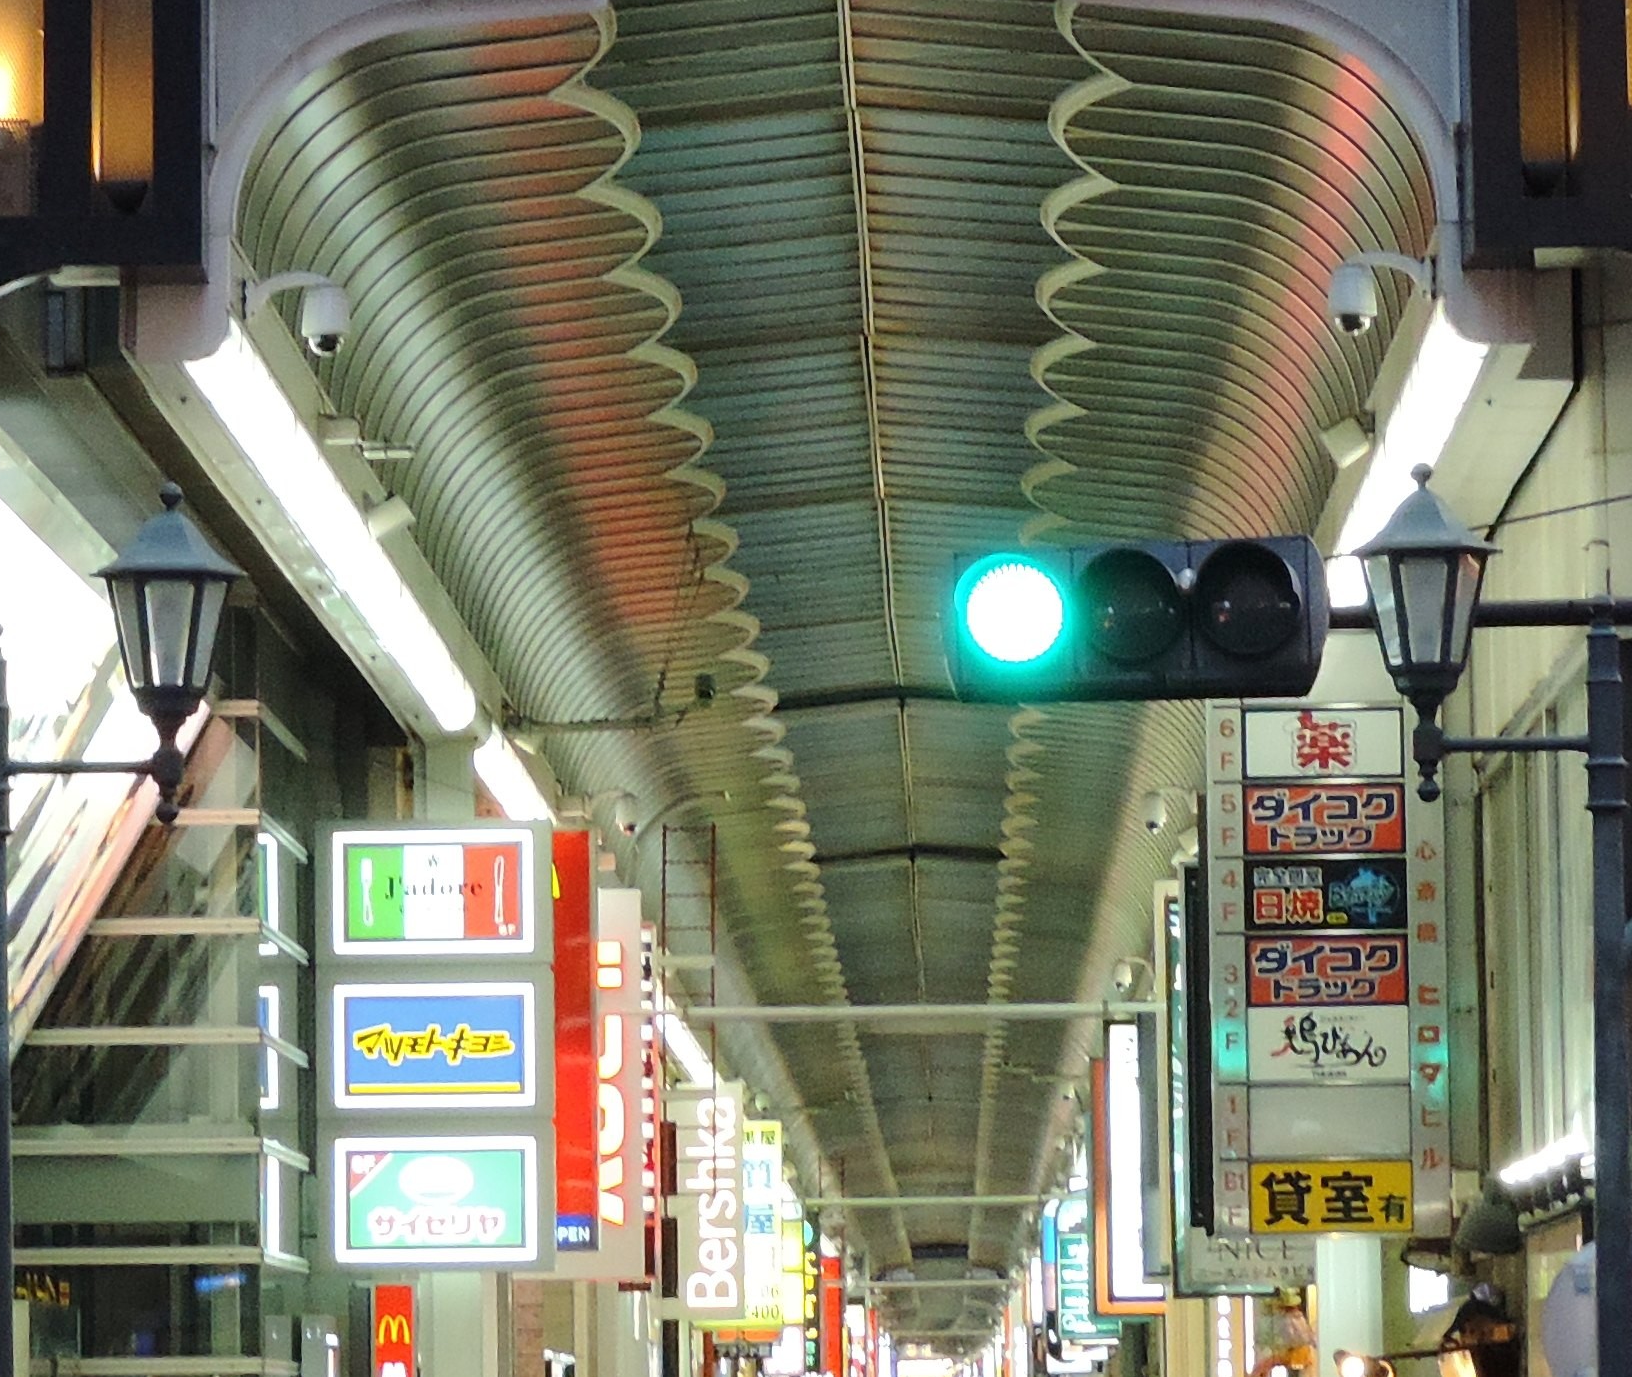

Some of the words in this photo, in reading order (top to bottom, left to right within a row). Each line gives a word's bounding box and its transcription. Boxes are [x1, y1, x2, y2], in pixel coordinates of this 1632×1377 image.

[1297, 710, 1352, 770] 薬
[1253, 789, 1395, 822] ダイコク
[1255, 889, 1323, 923] 日焼
[1255, 941, 1399, 974] ダイコク
[356, 1026, 513, 1063] マツモトキヨシ
[685, 1096, 739, 1309] Bershka
[554, 1225, 591, 1244] PEN
